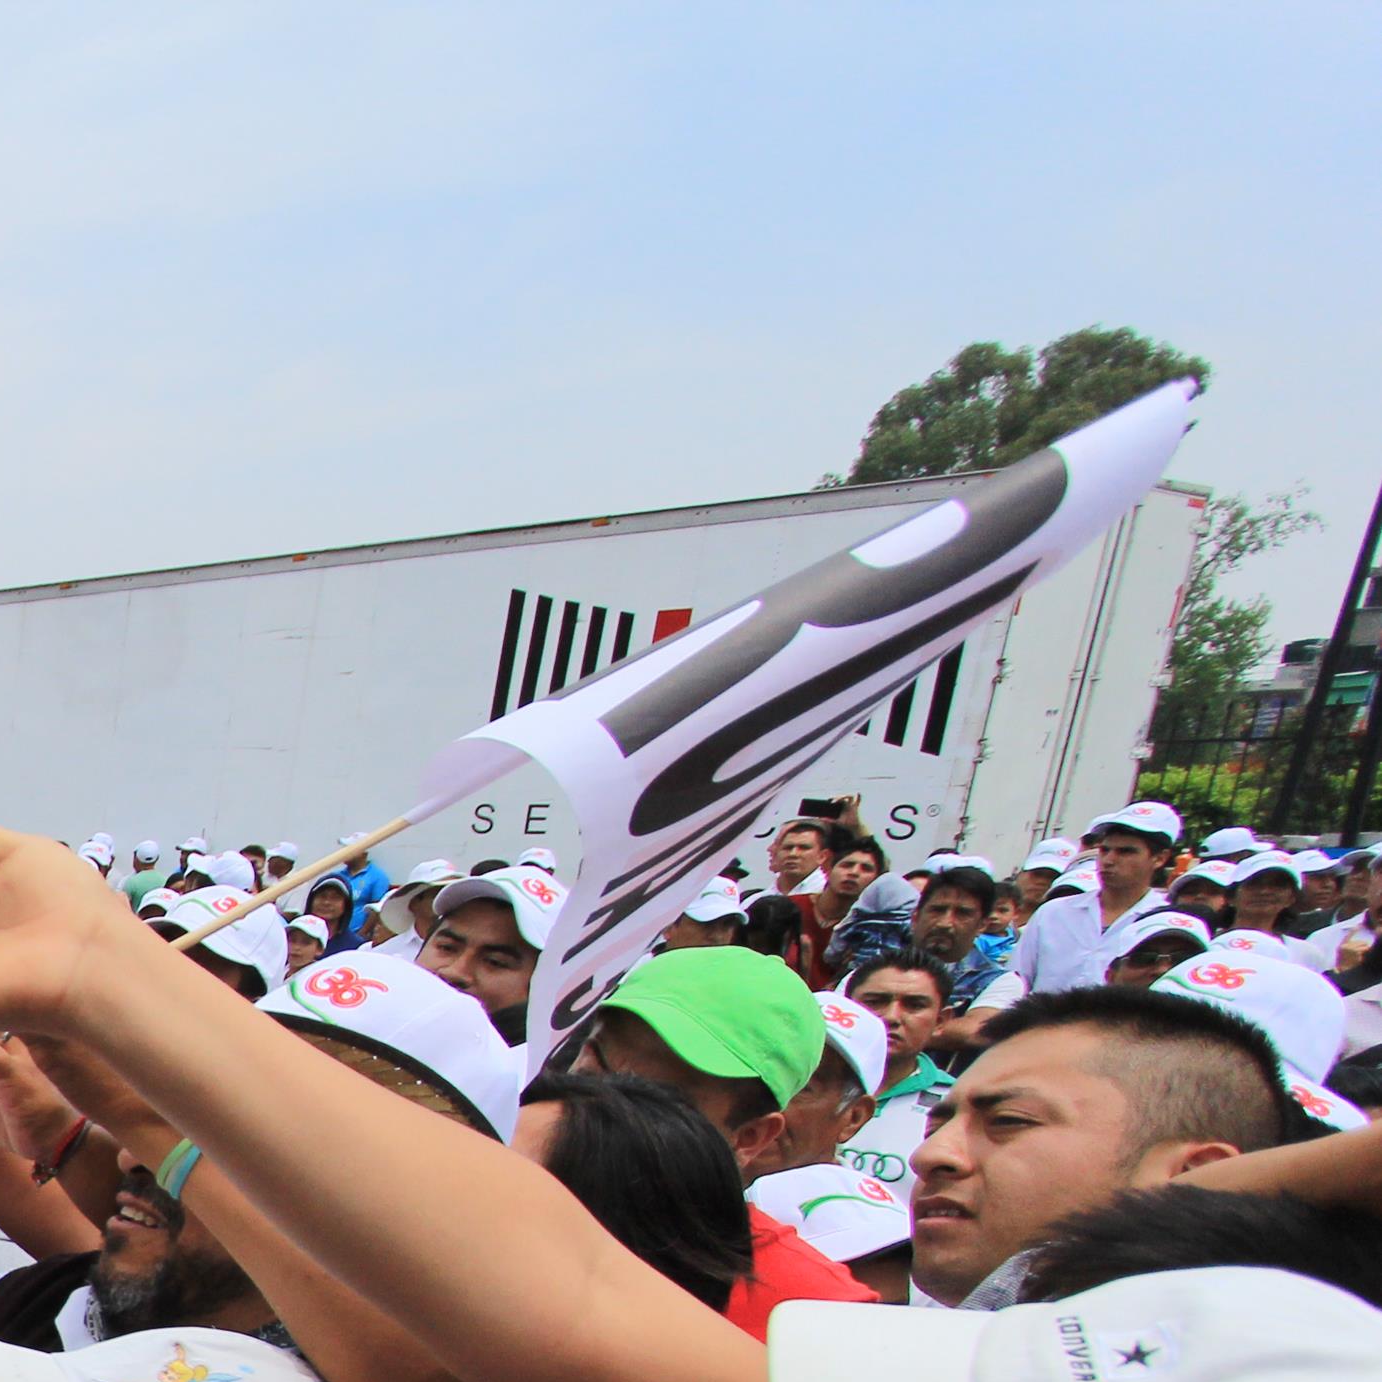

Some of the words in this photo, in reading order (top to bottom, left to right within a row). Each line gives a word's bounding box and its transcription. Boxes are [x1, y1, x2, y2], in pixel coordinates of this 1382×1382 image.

[212, 896, 239, 913] 3
[305, 966, 389, 1009] 36
[1188, 963, 1257, 990] 36
